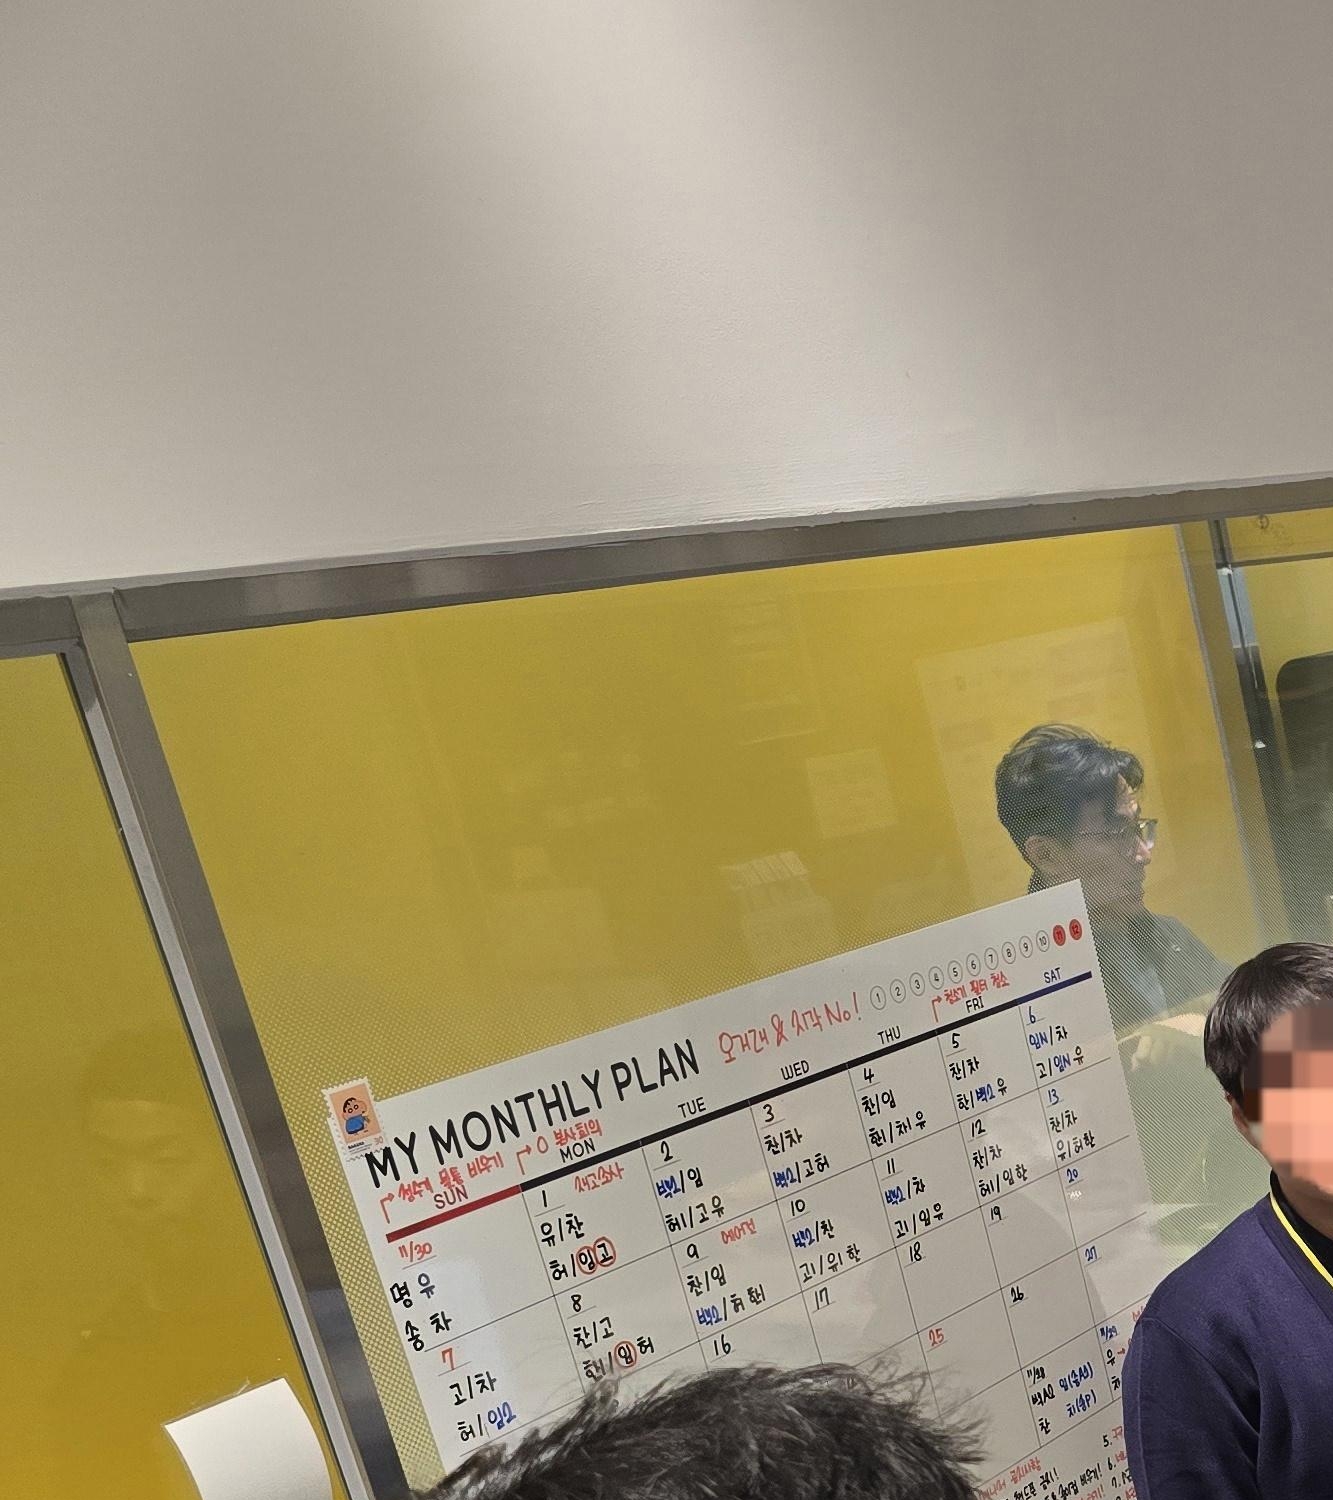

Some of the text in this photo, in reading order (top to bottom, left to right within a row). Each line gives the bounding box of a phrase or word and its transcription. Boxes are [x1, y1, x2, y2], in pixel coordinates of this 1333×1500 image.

[1028, 1005, 1036, 1024] 6
[951, 1032, 961, 1049] 5
[864, 1067, 875, 1083] 4
[434, 967, 1062, 1209] SUN MON TUE WED THU FRI SAT
[1048, 1088, 1059, 1105] 13
[365, 1038, 700, 1188] MY MONTHLY PLAN
[763, 1104, 774, 1122] 3
[971, 1119, 986, 1137] 12
[661, 1140, 674, 1162] 2
[887, 1158, 896, 1174] 11
[791, 1199, 806, 1217] 10
[398, 1242, 433, 1263] 11/30
[713, 1168, 1079, 1356] 16 17 18 19 20
[570, 1294, 582, 1312] 8
[928, 1246, 1098, 1347] 25 26 27
